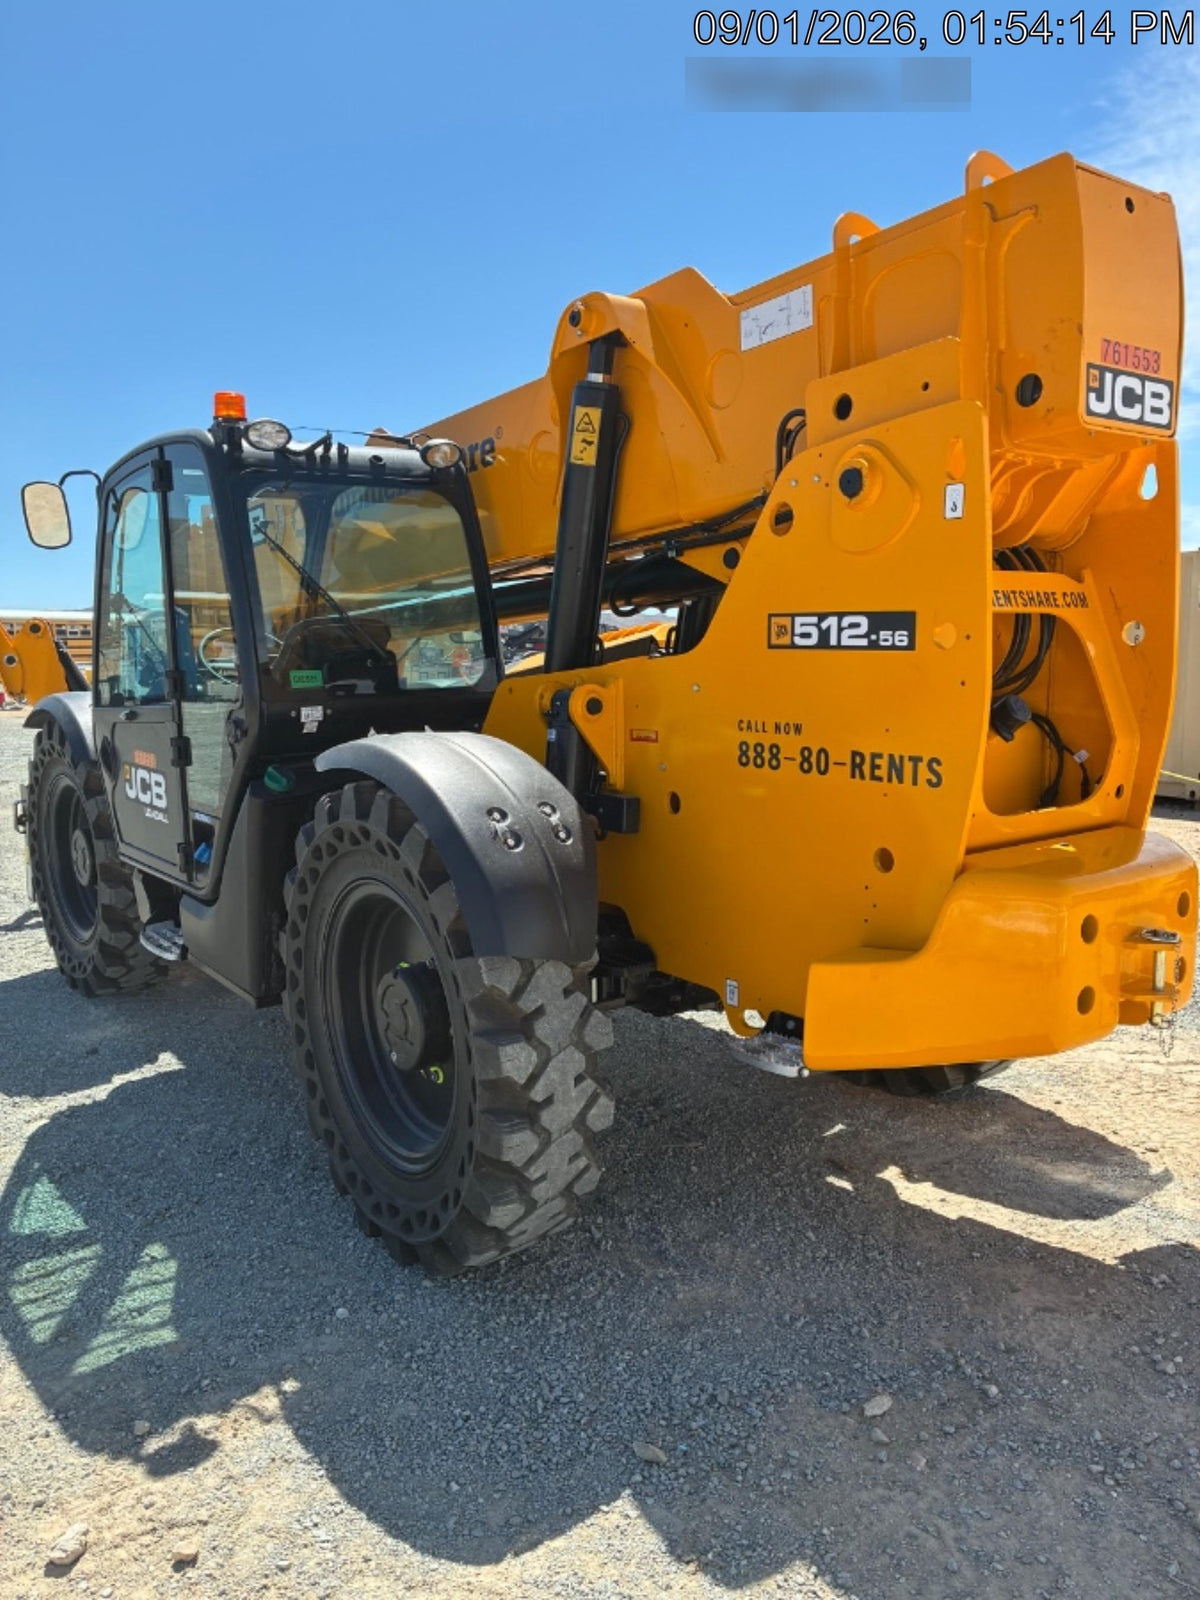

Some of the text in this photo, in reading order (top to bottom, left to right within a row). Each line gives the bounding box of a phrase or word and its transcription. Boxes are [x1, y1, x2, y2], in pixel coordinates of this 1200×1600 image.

[1102, 339, 1161, 374] 761553
[1088, 371, 1171, 425] JCB
[992, 589, 1089, 609] ENTSHARE.COM
[738, 719, 803, 736] CALL NOW
[738, 741, 943, 788] 888-80-RENTS
[125, 766, 168, 809] JCB
